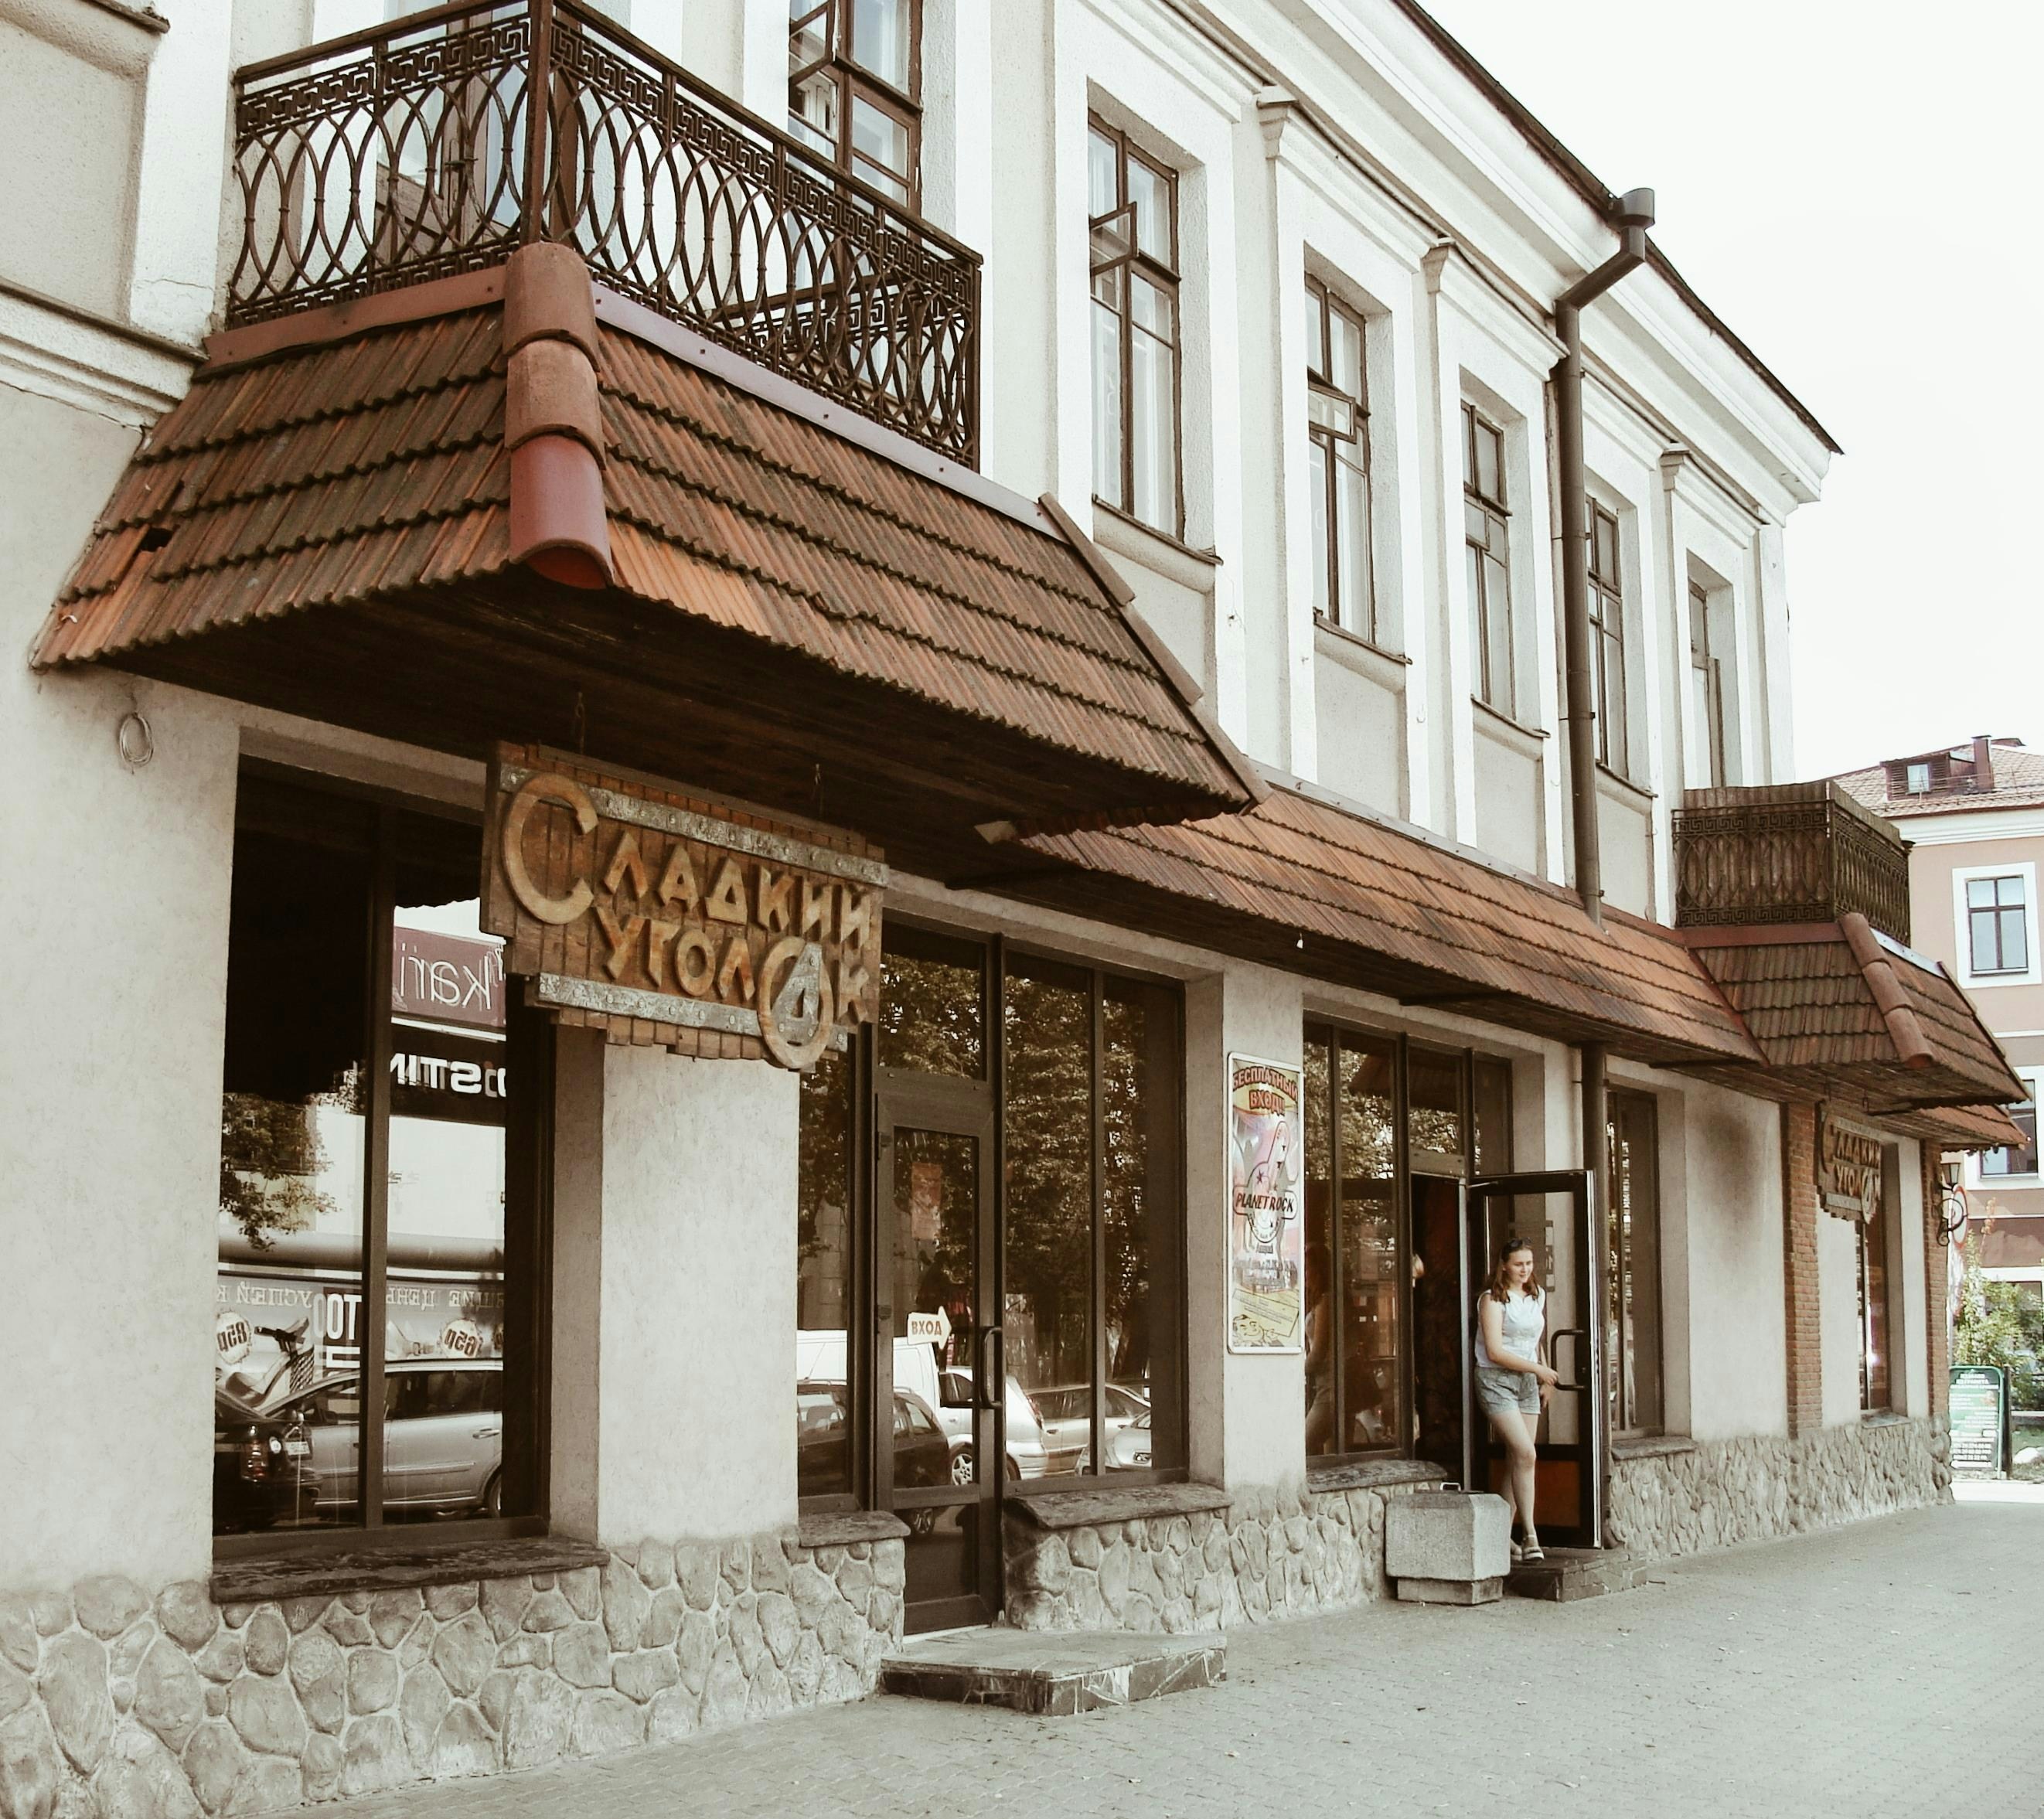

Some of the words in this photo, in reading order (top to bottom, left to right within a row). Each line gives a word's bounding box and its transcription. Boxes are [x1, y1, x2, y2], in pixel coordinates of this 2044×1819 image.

[593, 905, 870, 1068] УГОЛОК
[1233, 1066, 1298, 1102] БЕСПЛАТНЫЙ
[1235, 1193, 1269, 1210] PLANET
[1269, 1196, 1294, 1212] ROCK
[911, 1320, 942, 1335] ВХОД
